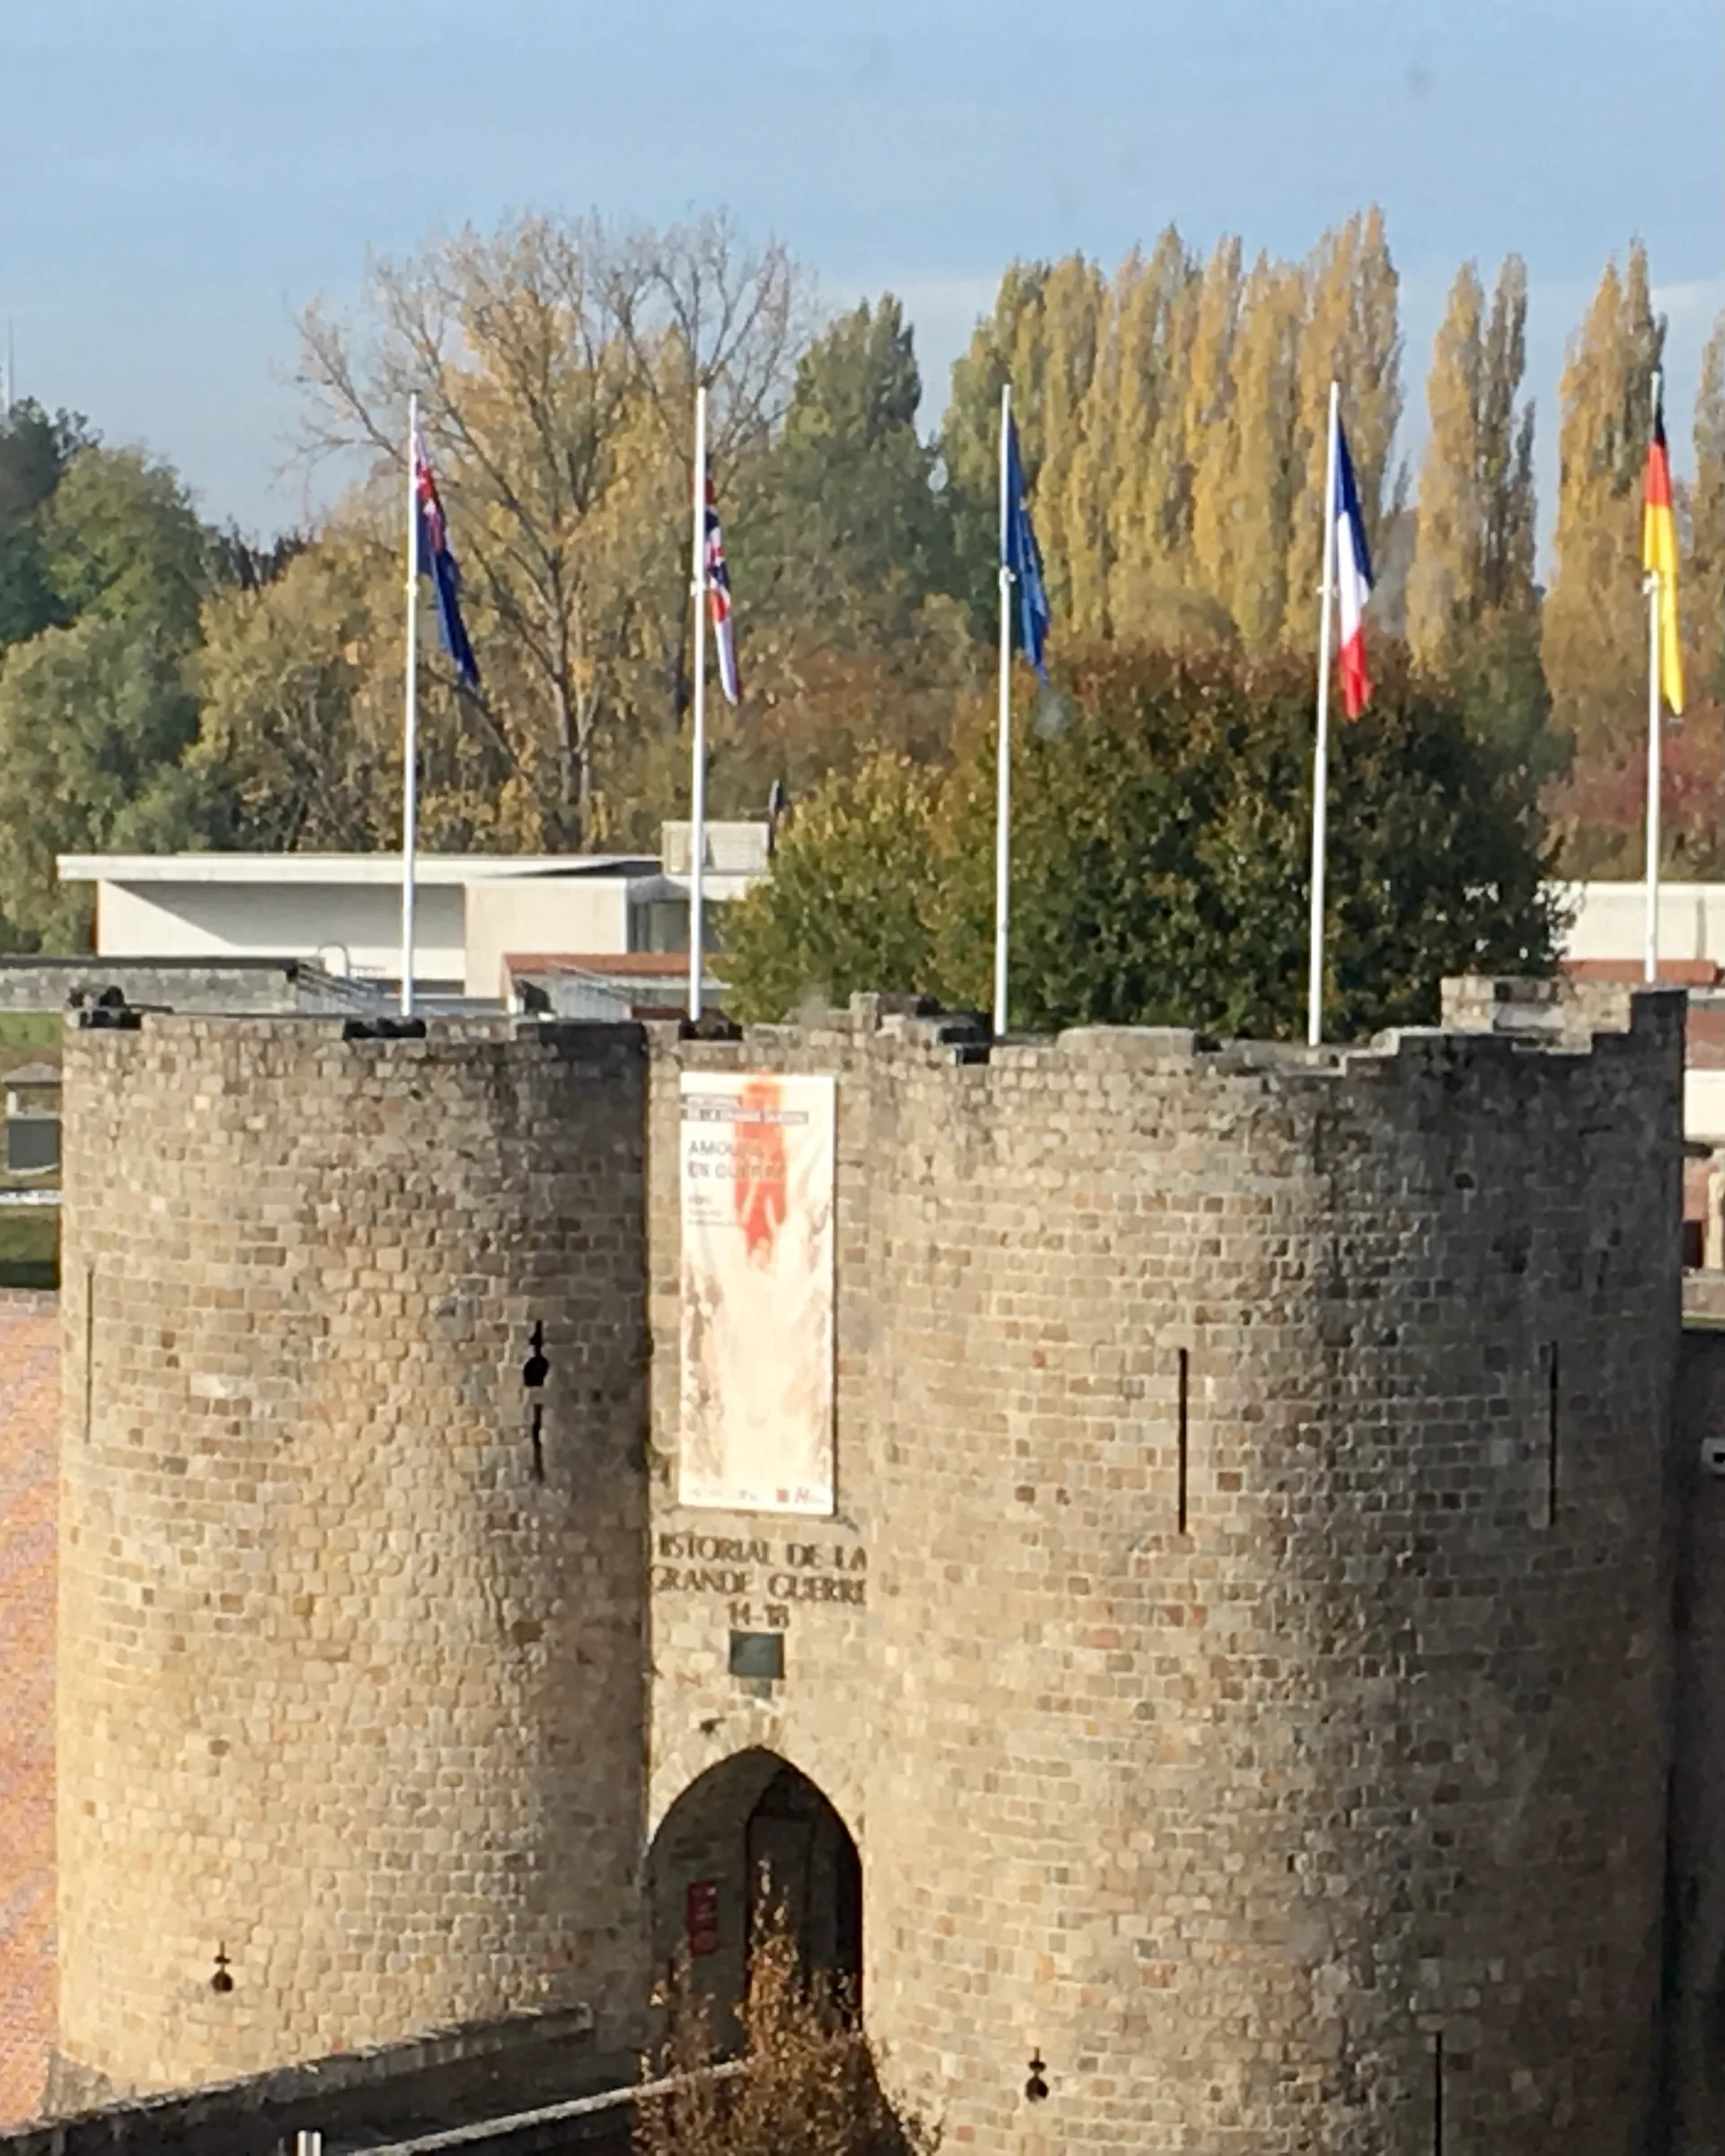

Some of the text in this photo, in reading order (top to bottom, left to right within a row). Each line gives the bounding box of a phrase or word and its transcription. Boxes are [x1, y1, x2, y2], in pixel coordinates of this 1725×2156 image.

[660, 1533, 868, 1571] ISTORIAL DE LA
